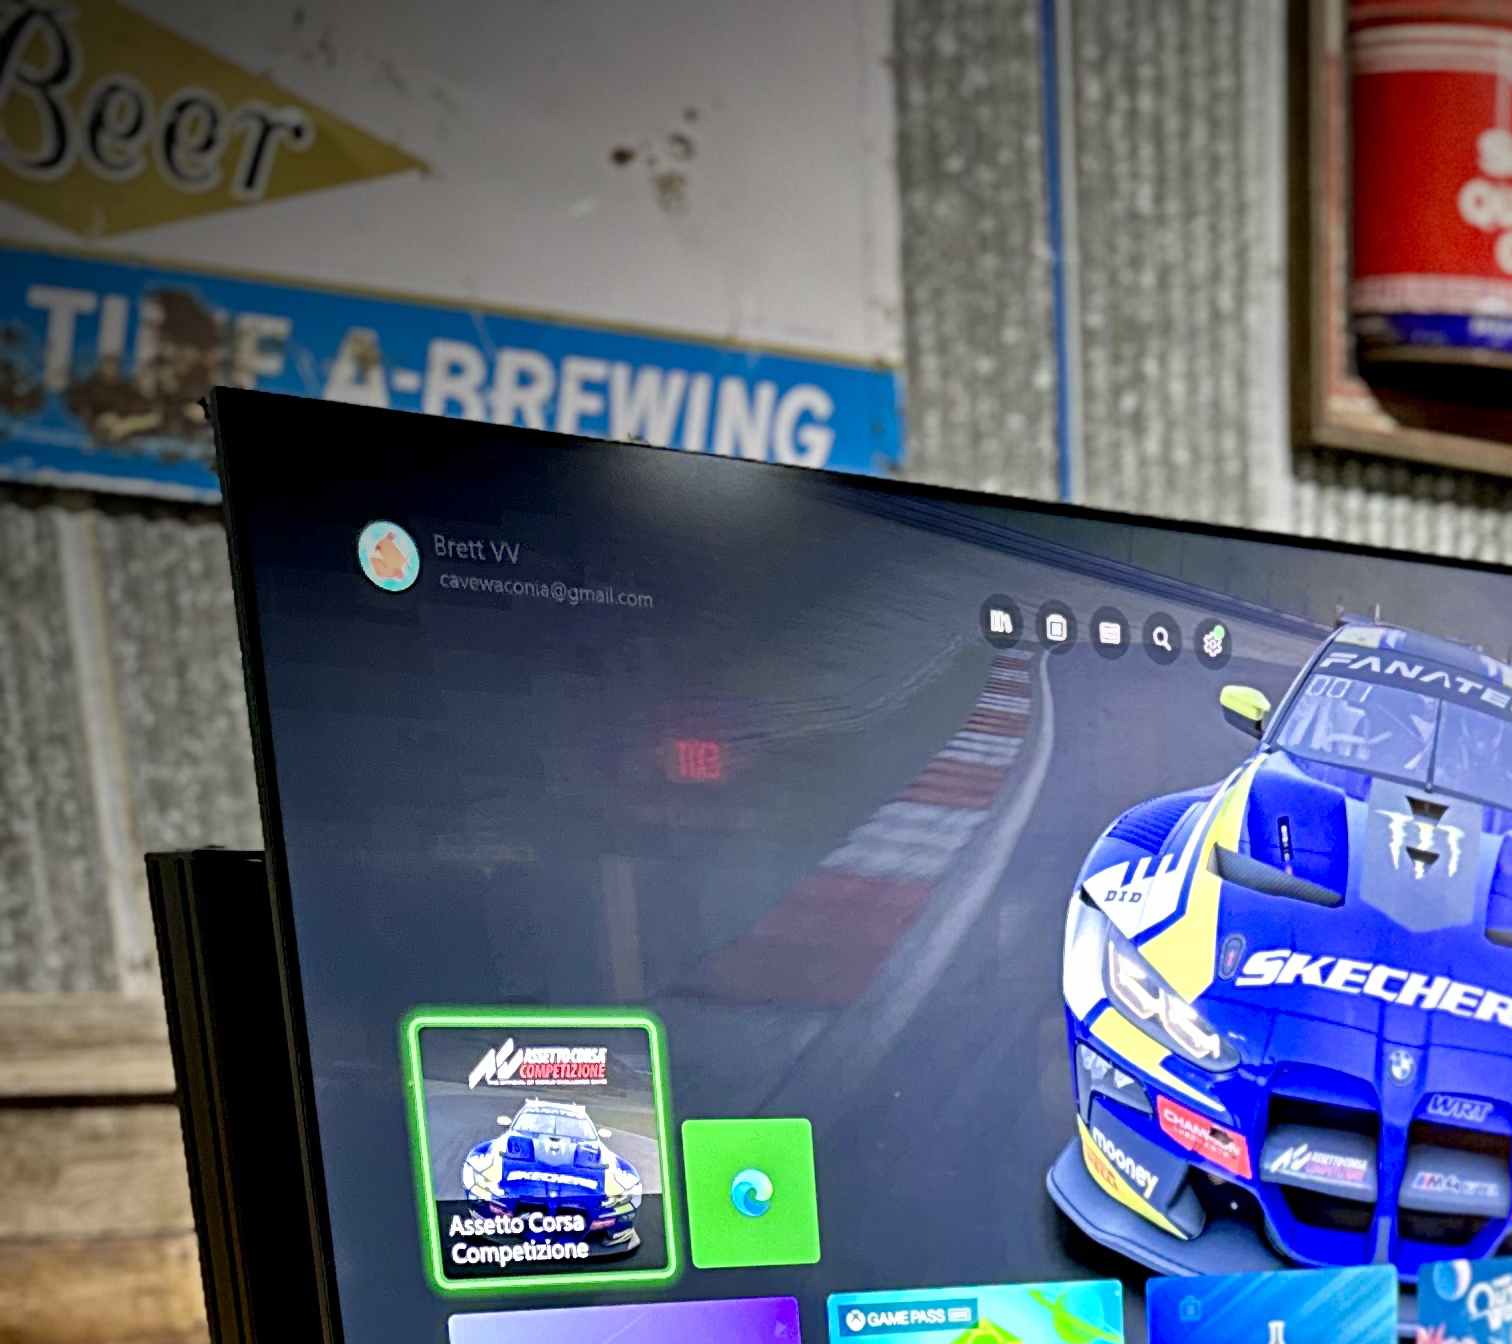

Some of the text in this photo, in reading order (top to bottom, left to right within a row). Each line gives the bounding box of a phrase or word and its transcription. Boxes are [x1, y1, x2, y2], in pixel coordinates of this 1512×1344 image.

[0, 3, 313, 199] Beer
[434, 534, 486, 561] Brett
[440, 573, 655, 608] cavewaconia@gmail.com
[519, 1063, 606, 1079] COMPETIZIONE
[1092, 1126, 1160, 1199] mooney
[449, 1211, 586, 1237] Assetto Corsa
[451, 1239, 590, 1268] Competizione
[867, 1310, 909, 1328] GAME
[911, 1308, 945, 1325] PASS
